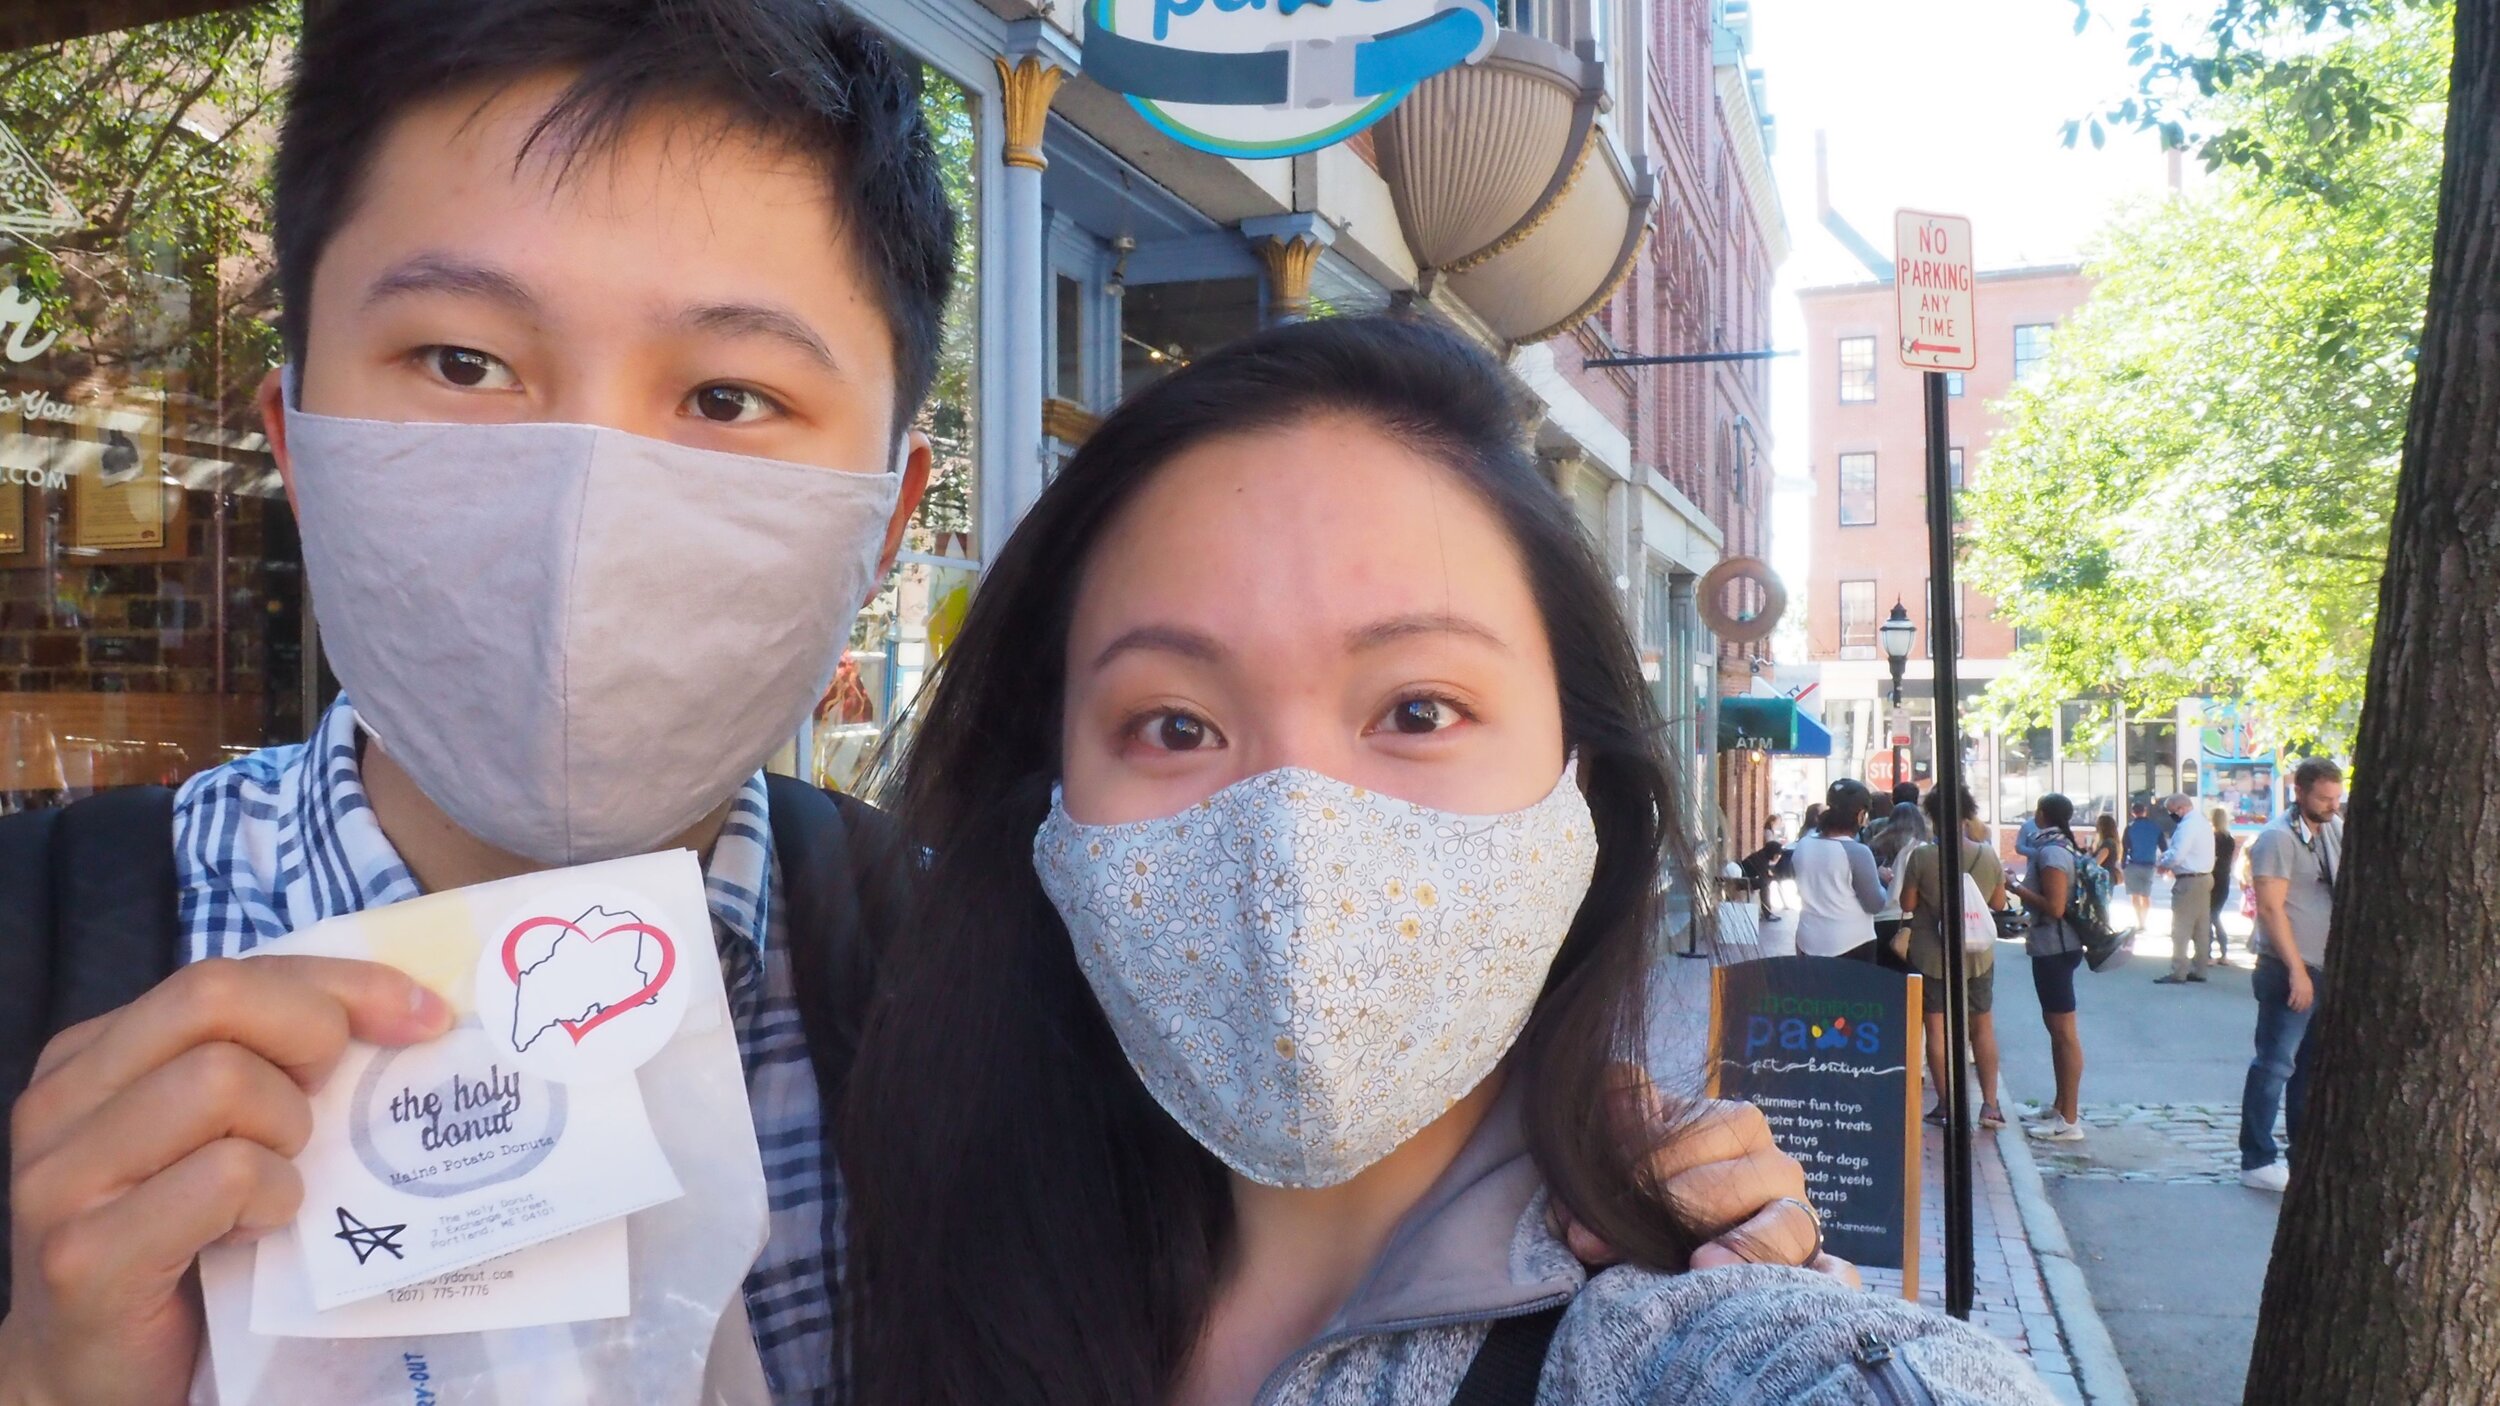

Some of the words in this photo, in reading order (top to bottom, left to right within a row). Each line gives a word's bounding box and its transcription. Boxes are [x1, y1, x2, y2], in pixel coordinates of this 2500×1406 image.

[1919, 226, 1947, 255] NO
[1901, 258, 1969, 292] PARKING
[1921, 293, 1950, 313] ANY
[1918, 316, 1955, 338] TIME
[21, 389, 75, 421] You
[1736, 736, 1774, 749] ATM
[1808, 1057, 1876, 1078] boutique
[390, 1087, 442, 1123] the
[454, 1064, 521, 1112] holy
[1752, 1093, 1805, 1109] Summer
[1810, 1098, 1831, 1112] fun
[1834, 1101, 1863, 1115] toys
[421, 1106, 512, 1151] donut
[1798, 1116, 1823, 1130] toys
[1835, 1118, 1873, 1132] treats
[1788, 1133, 1818, 1148] toys
[390, 1164, 438, 1186] Maine
[443, 1149, 495, 1172] Potato
[501, 1136, 554, 1156] Donuts
[1816, 1150, 1834, 1164] for
[1836, 1153, 1870, 1170] dogs
[1840, 1174, 1874, 1187] vests
[1808, 1187, 1847, 1202] treats
[432, 1284, 489, 1299] 775-7776
